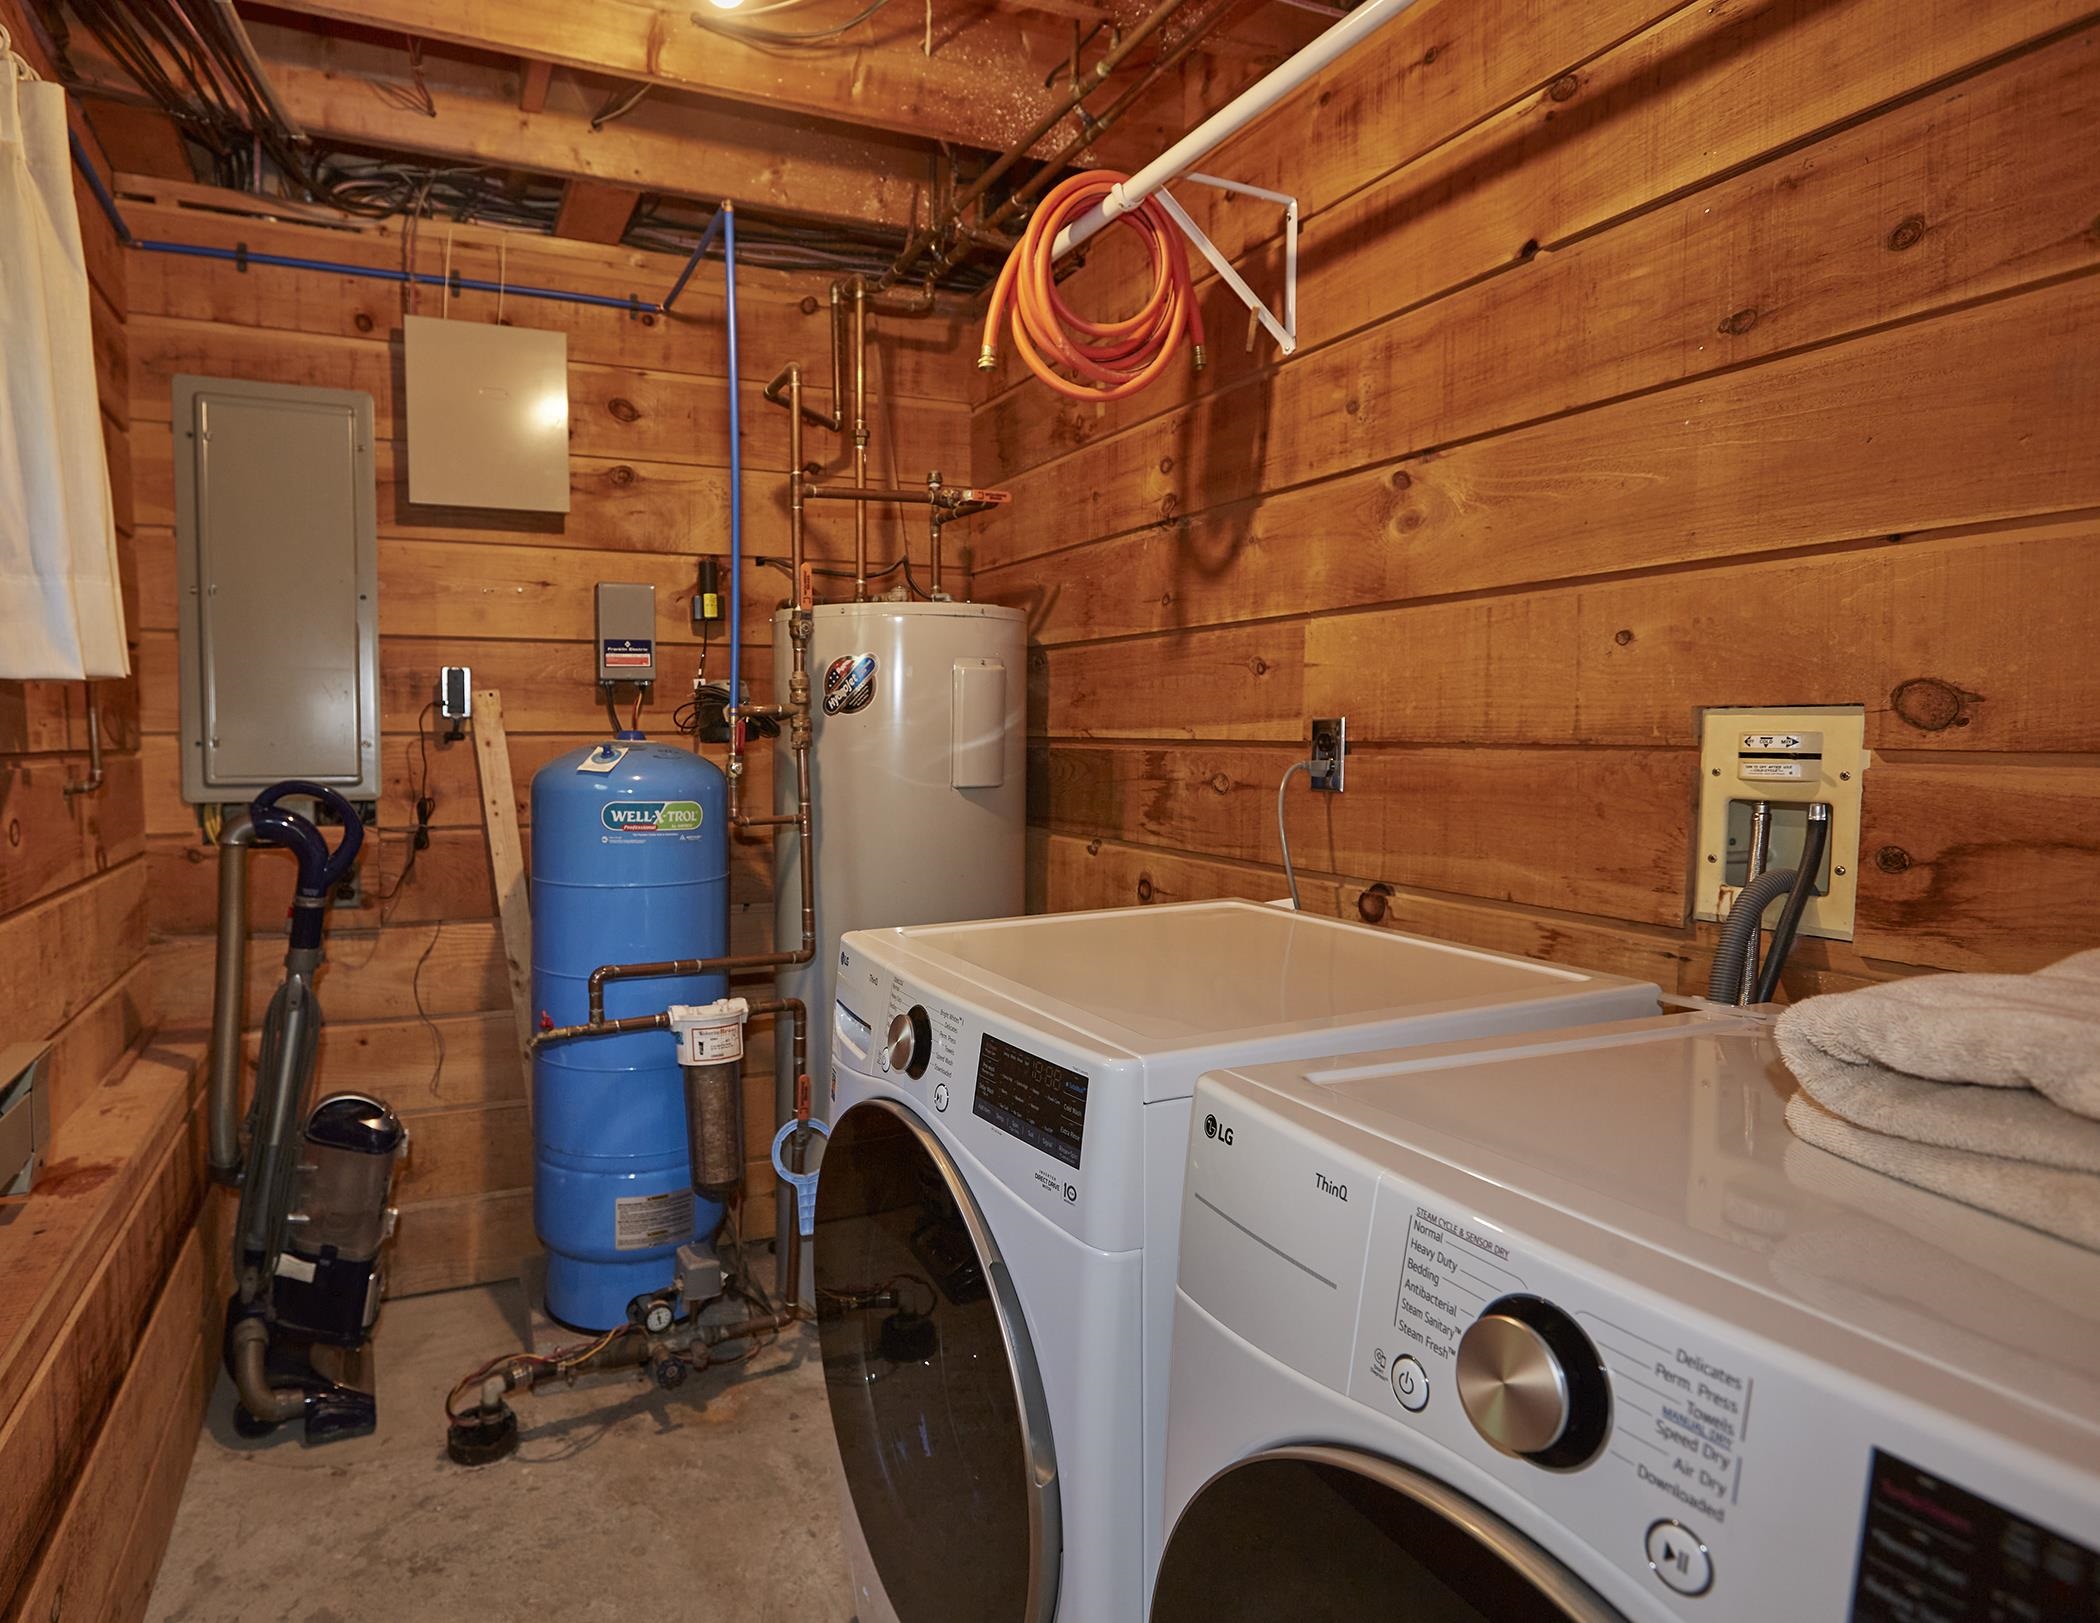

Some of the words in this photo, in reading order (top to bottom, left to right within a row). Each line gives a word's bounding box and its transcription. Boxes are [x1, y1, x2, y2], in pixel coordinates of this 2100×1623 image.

[1218, 1123, 1234, 1146] LG
[1035, 1172, 1048, 1184] DIRECT
[1048, 1181, 1060, 1191] DRIVE
[1063, 1182, 1077, 1202] 10
[1315, 1172, 1348, 1202] ThinQ
[1413, 1219, 1444, 1244] Normal
[1416, 1207, 1438, 1222] STEAM
[1438, 1217, 1458, 1233] CYCLE
[1459, 1228, 1465, 1237] &
[1466, 1231, 1493, 1250] SENSOR
[1494, 1245, 1510, 1258] DRY
[1407, 1258, 1440, 1287] Bedding
[1410, 1237, 1435, 1262] Heavy
[1436, 1251, 1458, 1274] Duty
[1401, 1298, 1423, 1319] Steam
[1404, 1279, 1457, 1318] Antibacterial
[1398, 1319, 1424, 1344] Steam
[1675, 1348, 1743, 1390] Delicates
[1655, 1362, 1693, 1393] Perm.
[1698, 1383, 1739, 1414] Press
[1662, 1405, 1705, 1434] MANUAL
[1709, 1428, 1733, 1449] DRY
[1687, 1400, 1735, 1437] Towels
[1655, 1419, 1699, 1453] Speed
[1702, 1443, 1730, 1472] Dry
[1637, 1463, 1726, 1524] Downloaded
[1672, 1457, 1695, 1477] Air
[1699, 1470, 1727, 1498] Dry
